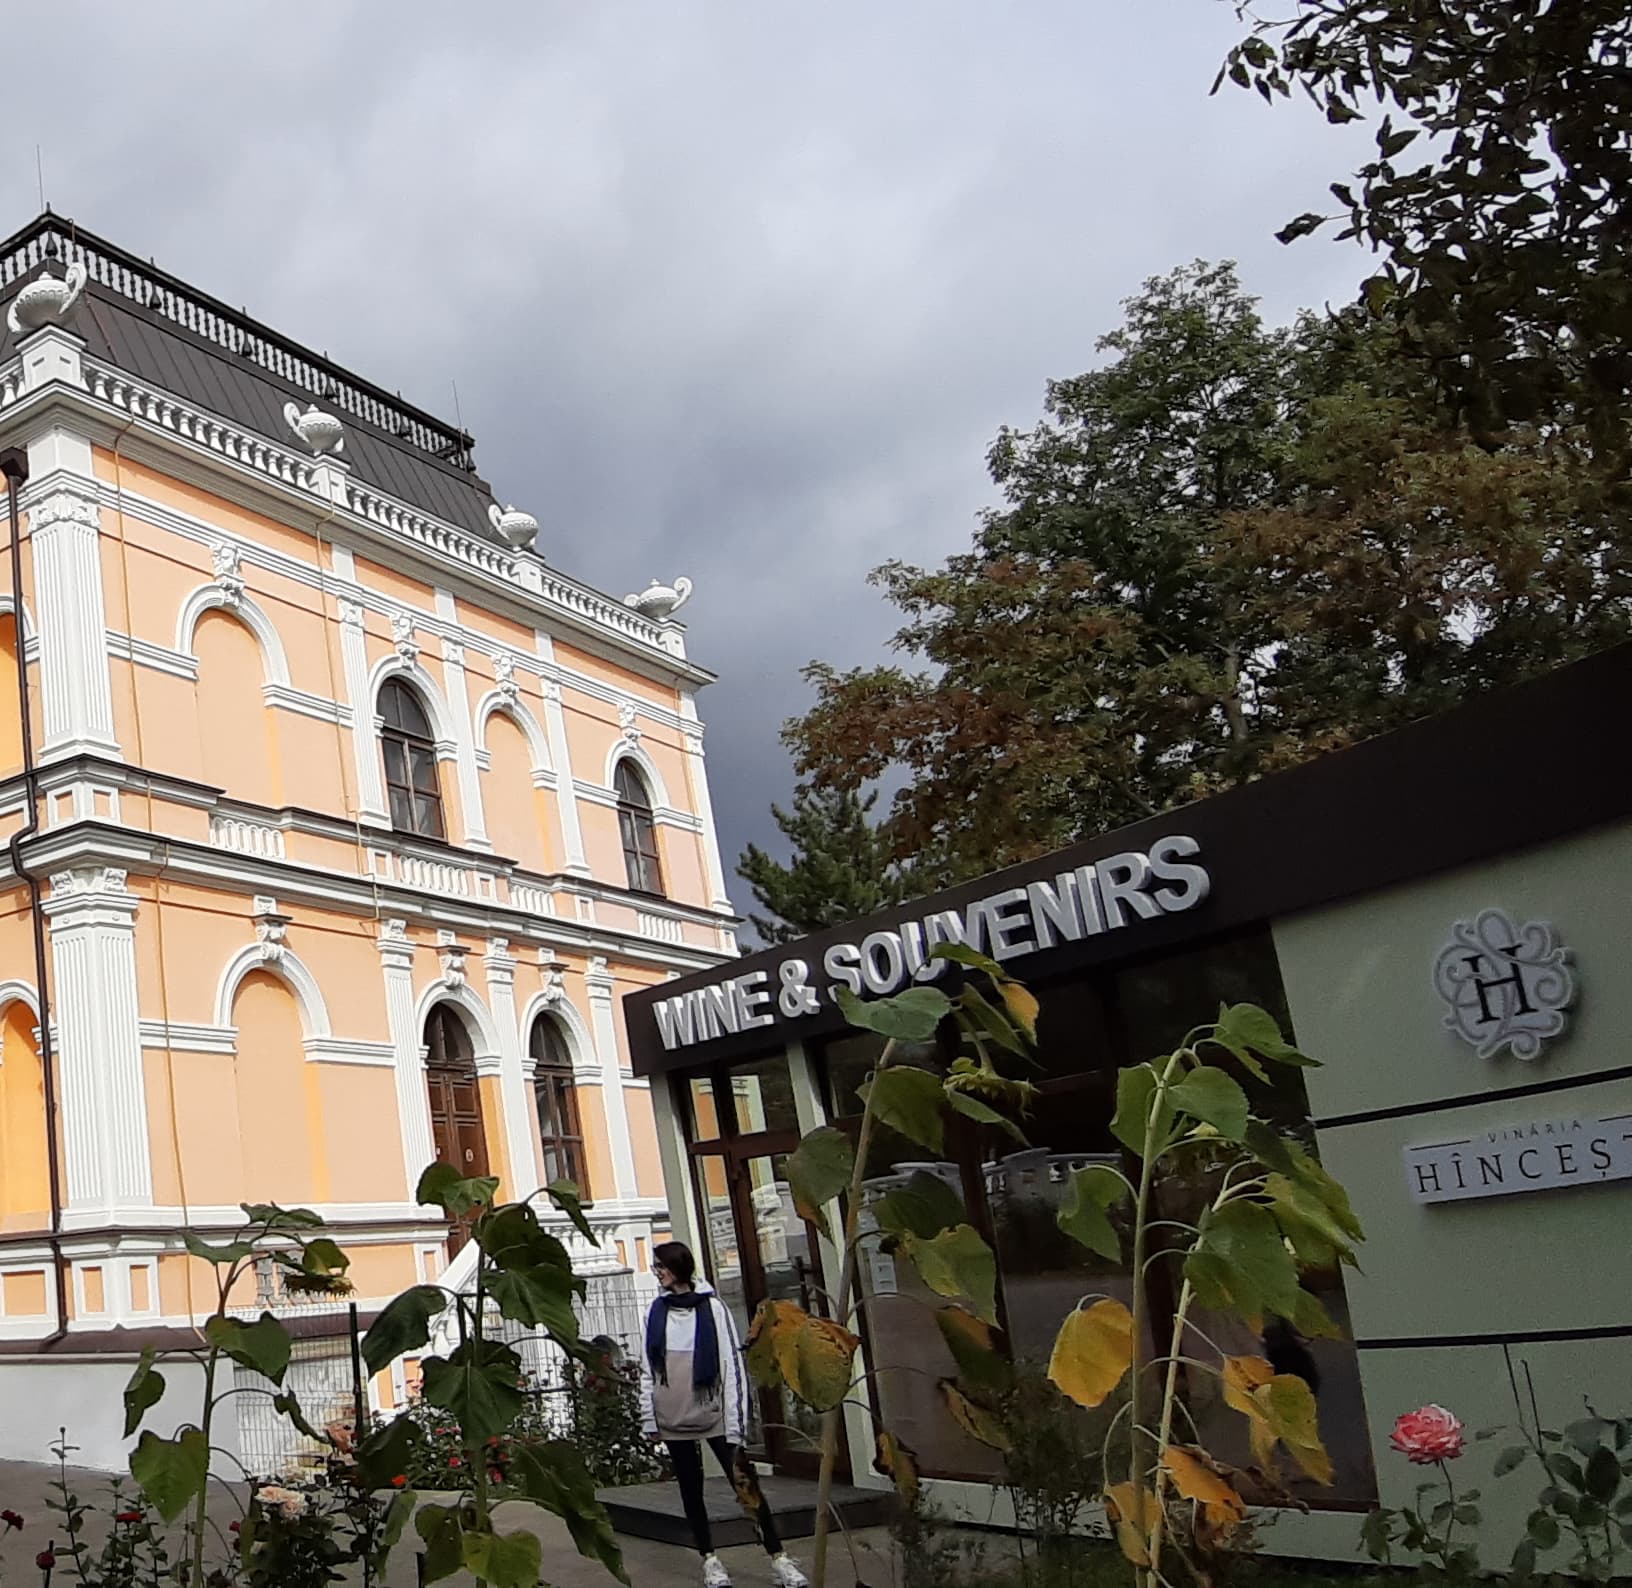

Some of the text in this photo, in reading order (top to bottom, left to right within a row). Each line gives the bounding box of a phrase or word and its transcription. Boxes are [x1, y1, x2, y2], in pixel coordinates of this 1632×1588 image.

[652, 835, 1211, 1051] WINE & SOUVENIRS
[1462, 945, 1538, 1024] H
